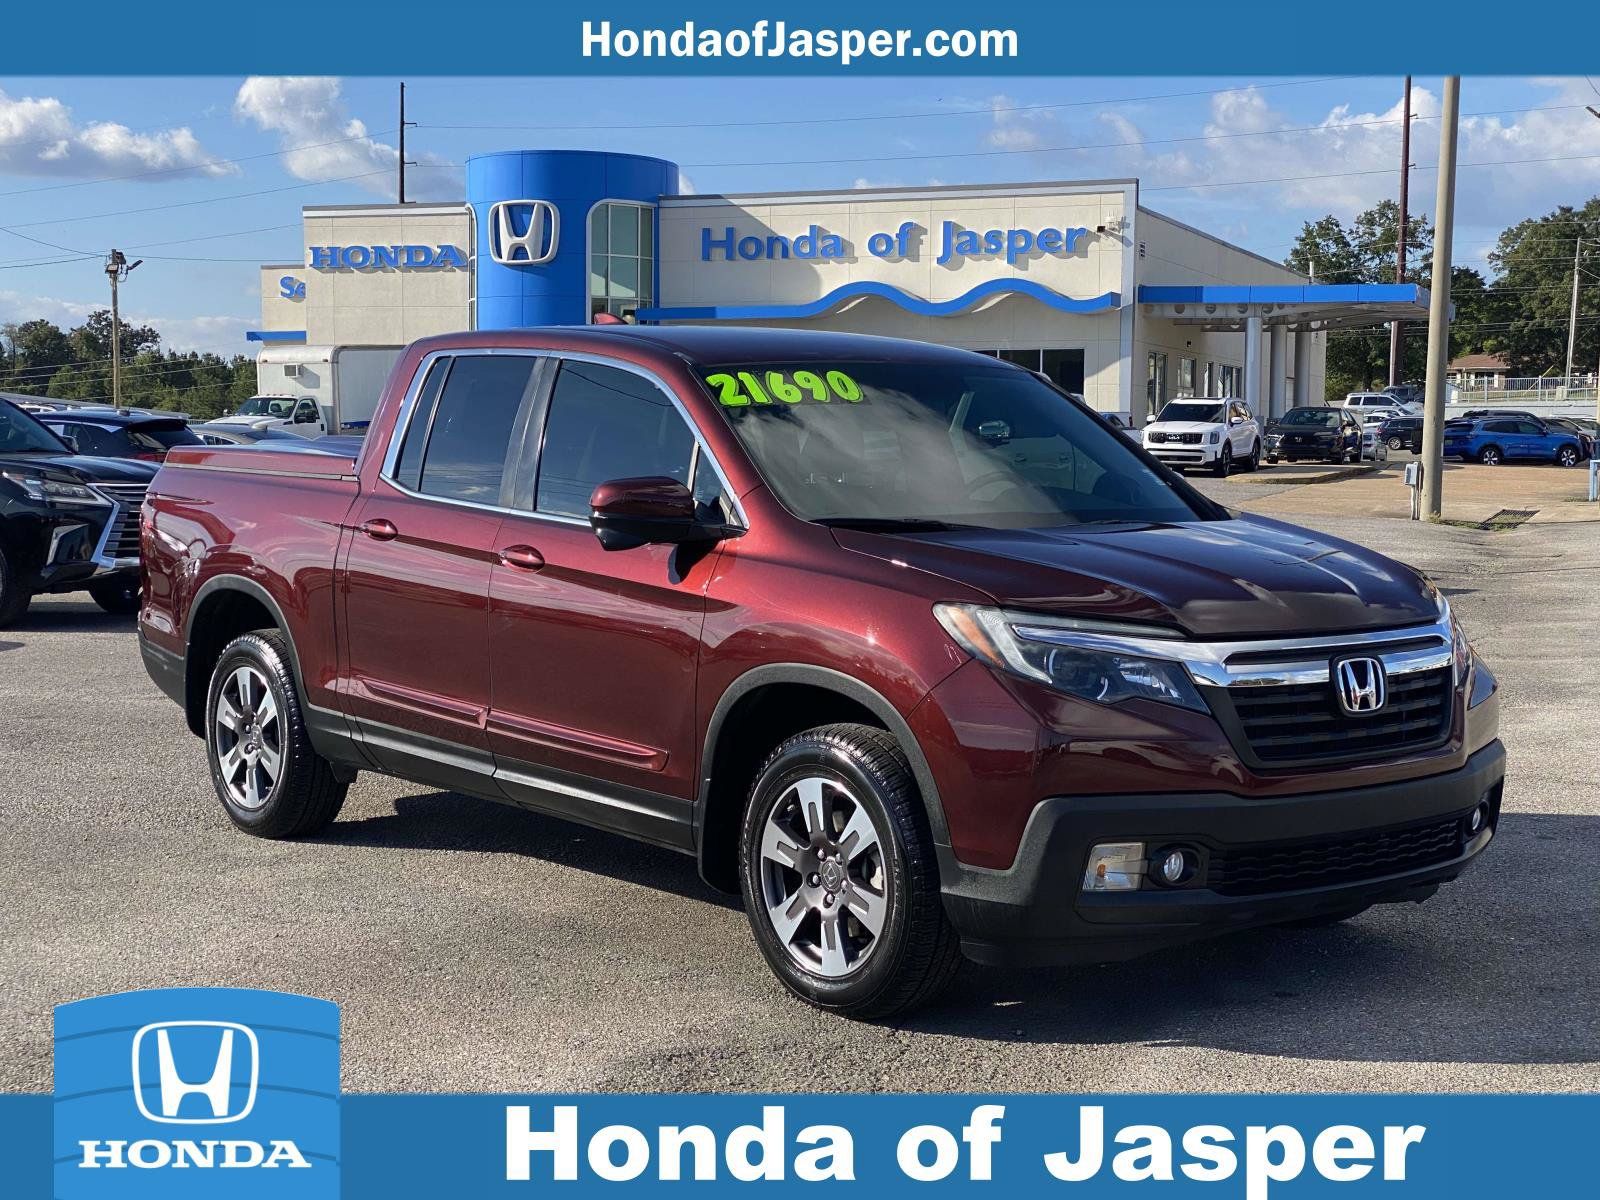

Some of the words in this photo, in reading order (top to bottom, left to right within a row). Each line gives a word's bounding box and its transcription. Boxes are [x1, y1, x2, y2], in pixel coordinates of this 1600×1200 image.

[309, 244, 468, 269] HONDA
[701, 225, 847, 262] Honda
[867, 222, 917, 258] of
[936, 220, 1088, 265] Jasper
[705, 370, 864, 407] 21690
